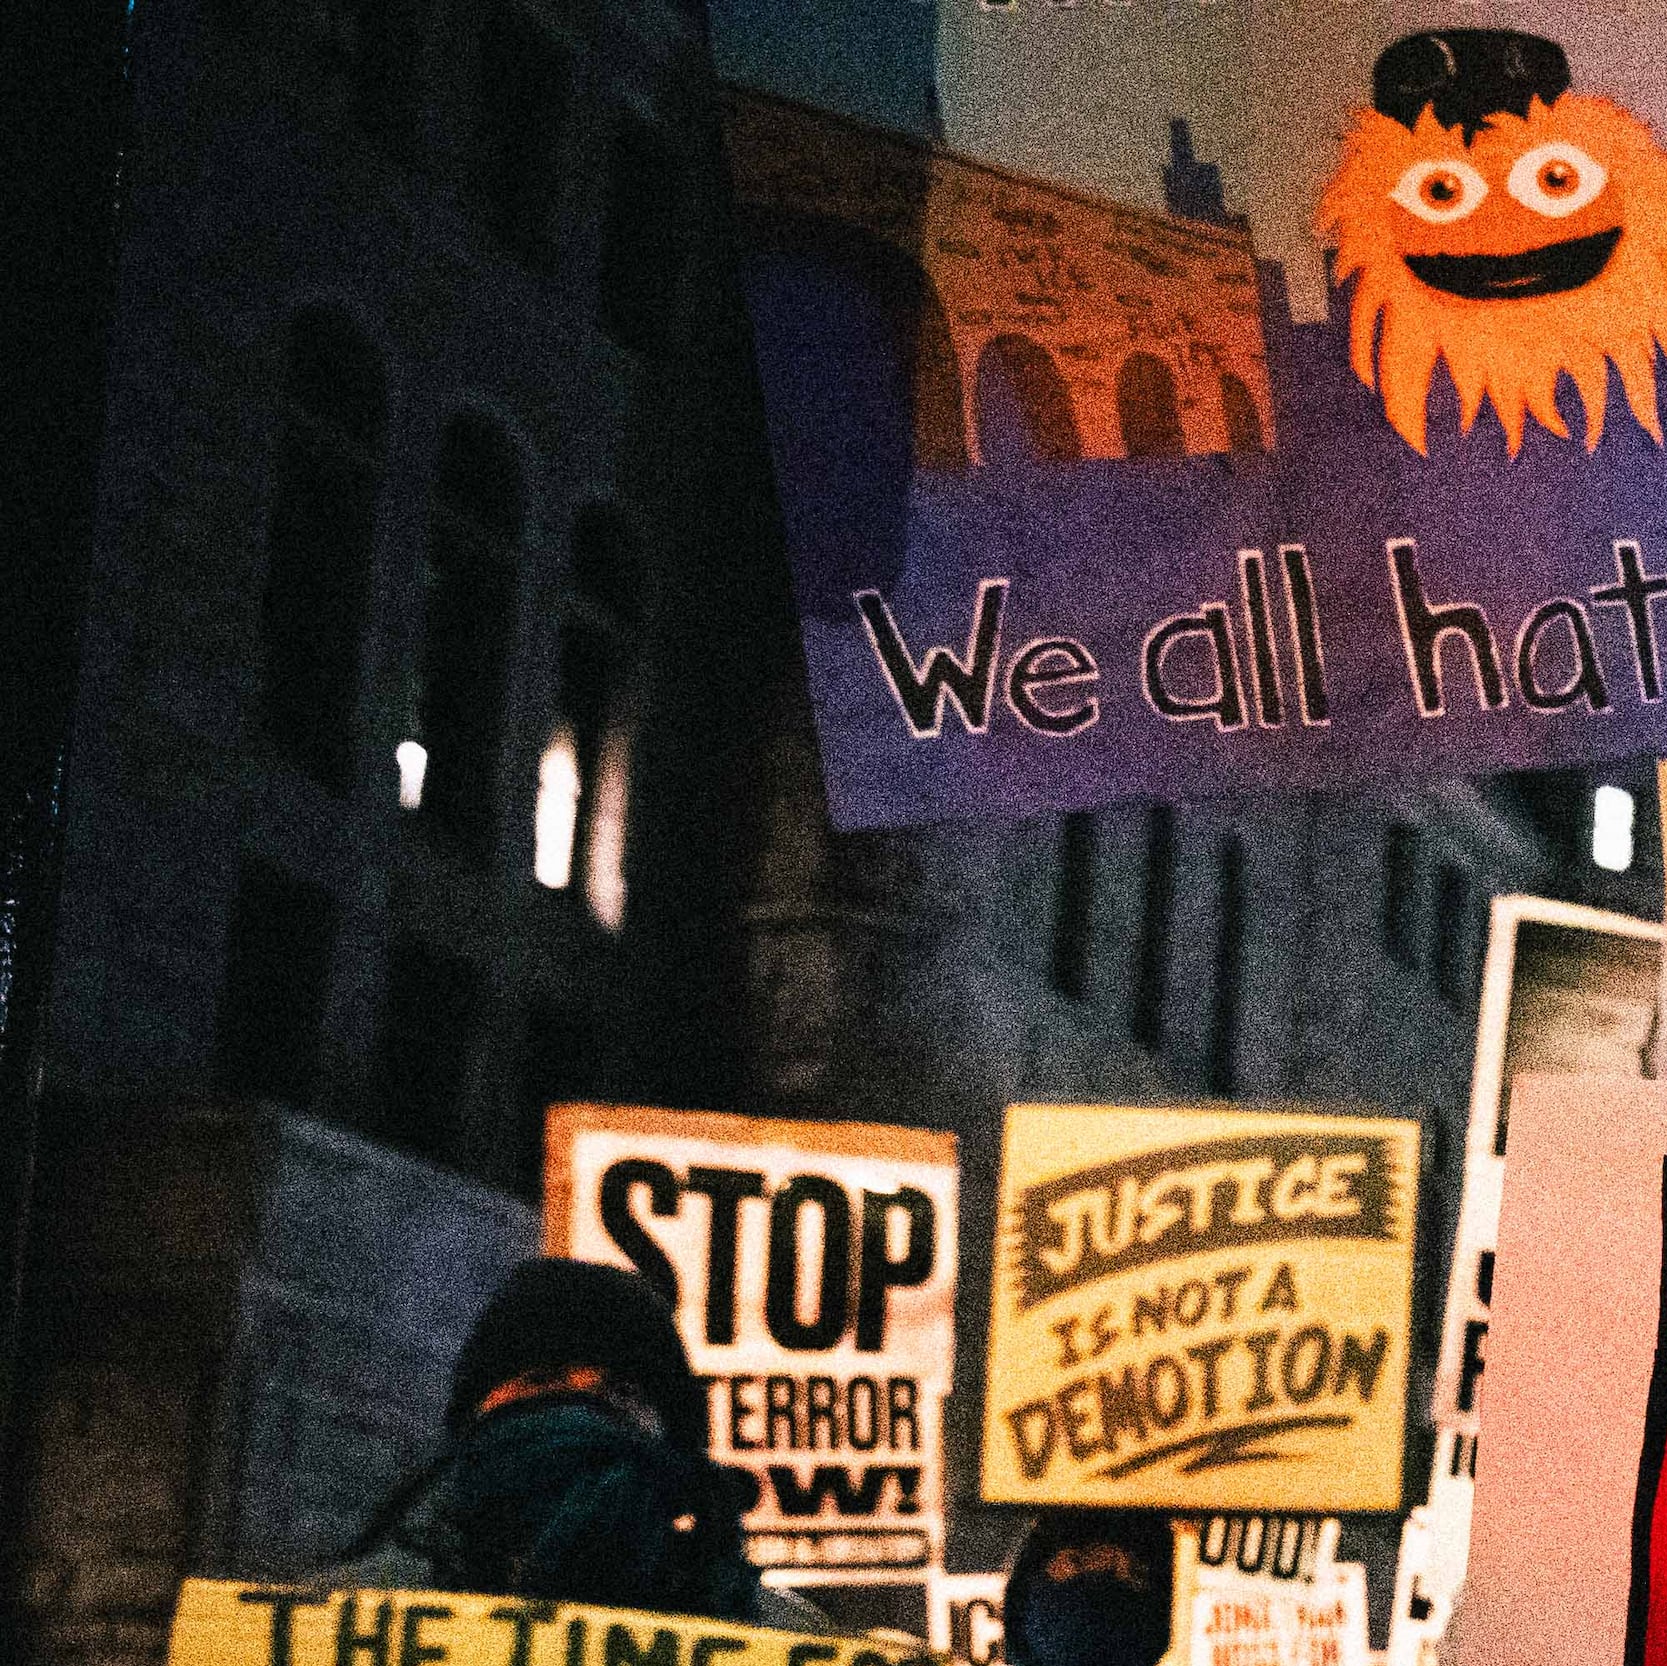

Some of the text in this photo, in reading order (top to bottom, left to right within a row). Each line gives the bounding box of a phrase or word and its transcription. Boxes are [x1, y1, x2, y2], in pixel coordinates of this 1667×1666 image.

[853, 578, 1100, 738] We
[1143, 543, 1331, 732] all
[598, 1158, 937, 1351] STOP
[1043, 1151, 1366, 1280] JUSTICE
[1051, 1261, 1300, 1362] IS NOT A
[1004, 1323, 1391, 1480] DEMOTION
